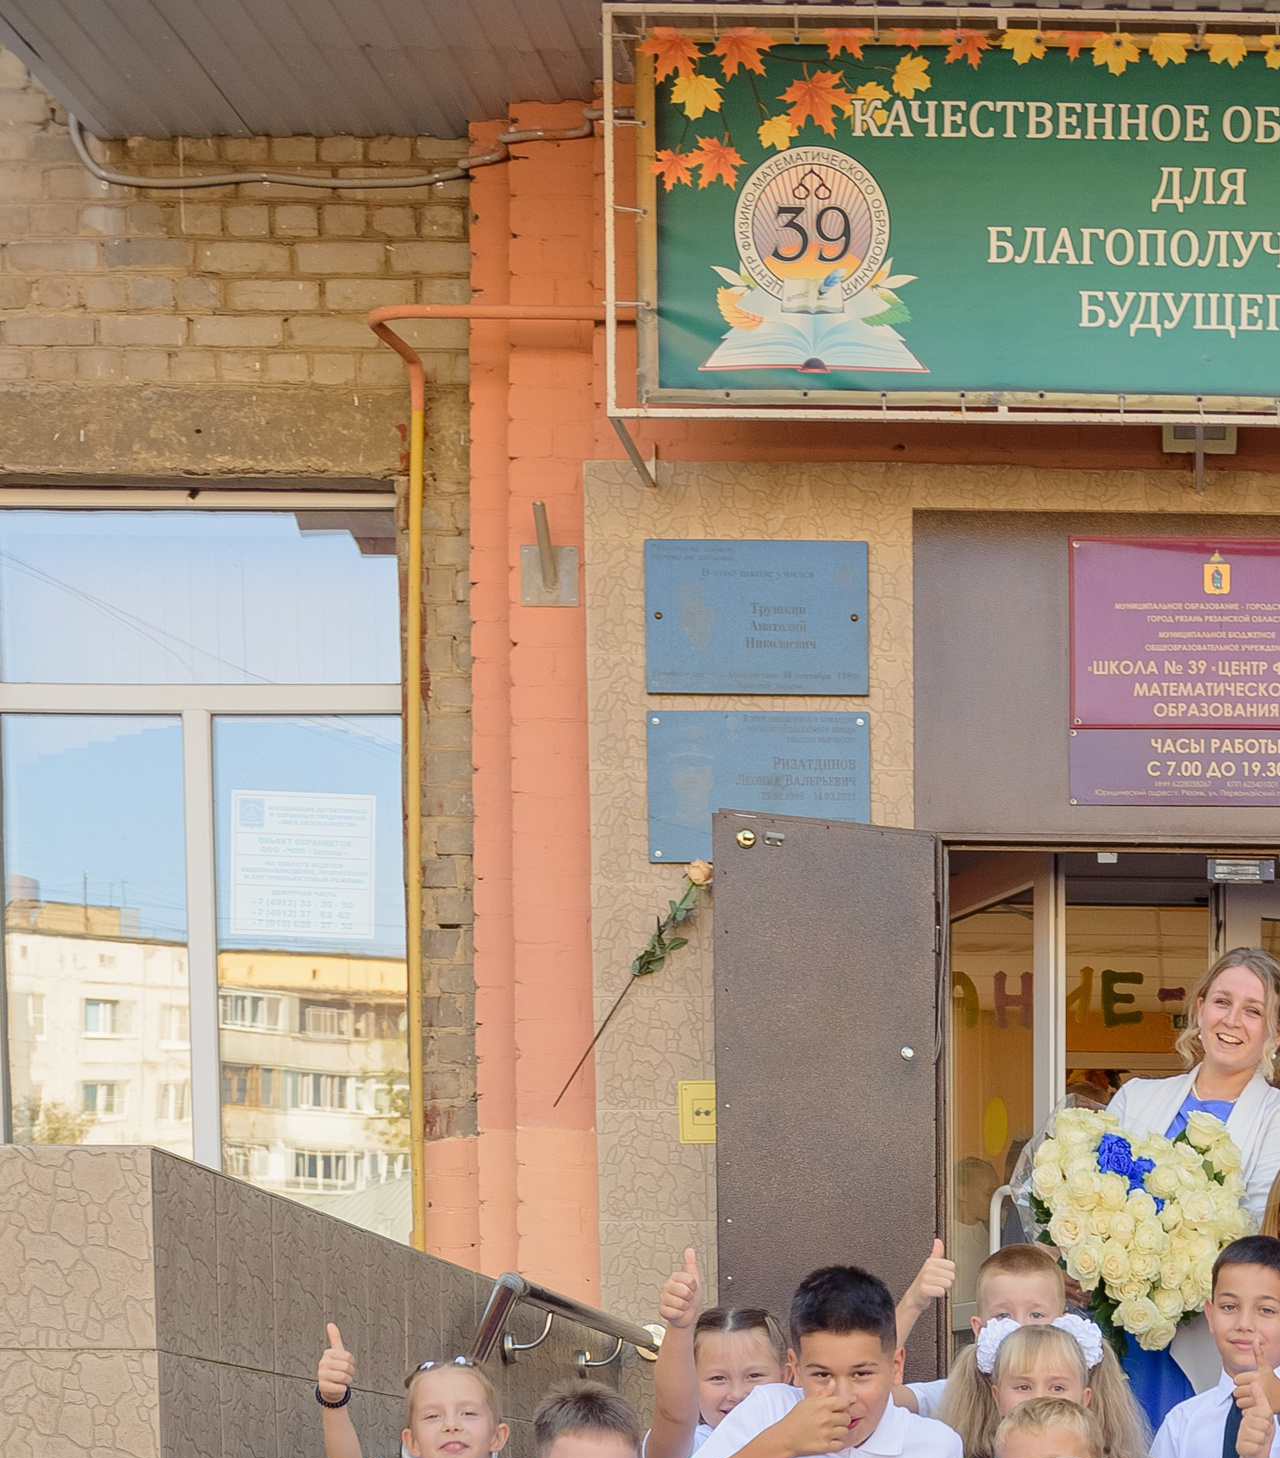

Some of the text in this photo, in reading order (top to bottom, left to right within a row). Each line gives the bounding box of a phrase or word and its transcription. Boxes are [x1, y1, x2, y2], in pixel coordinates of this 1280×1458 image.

[851, 100, 1210, 142] КАЧЕСТВЕННОЕ
[1151, 166, 1247, 213] ДЛЯ
[739, 150, 887, 297] ЦЕНТР ФИЗИКО-МАТЕМАТИЧЕСКОГО ОБРАЗОВАНИЯ
[771, 205, 852, 263] 39
[1114, 603, 1183, 611] МУНИЦИПАЛЬНОЕ
[1184, 603, 1239, 611] ОБРАЗОВАНИЕ
[1147, 615, 1174, 623] ГОРОД
[1204, 614, 1250, 623] РЯЗАНСКОЙ
[1158, 631, 1276, 639] МУНИЦИПАЛЬНОЕ БЮДЖЕТНОЕ
[1144, 644, 1239, 652] ОБЩЕОБРАЗОВАТЕЛЬНОЕ
[1087, 660, 1159, 675] «ШКОЛА
[1164, 660, 1184, 674] №
[1187, 660, 1208, 675] 39
[1150, 738, 1205, 754] ЧАСЫ
[1146, 761, 1161, 776] С
[1166, 761, 1202, 776] 7.00
[1206, 761, 1236, 778] ДО
[258, 837, 352, 847] ОБЪЕКТ ОХРАНЯЕТСЯ
[341, 901, 354, 909] 50
[299, 910, 311, 918] 37
[320, 911, 333, 919] 62
[320, 921, 332, 929] 27
[341, 922, 354, 930] 52
